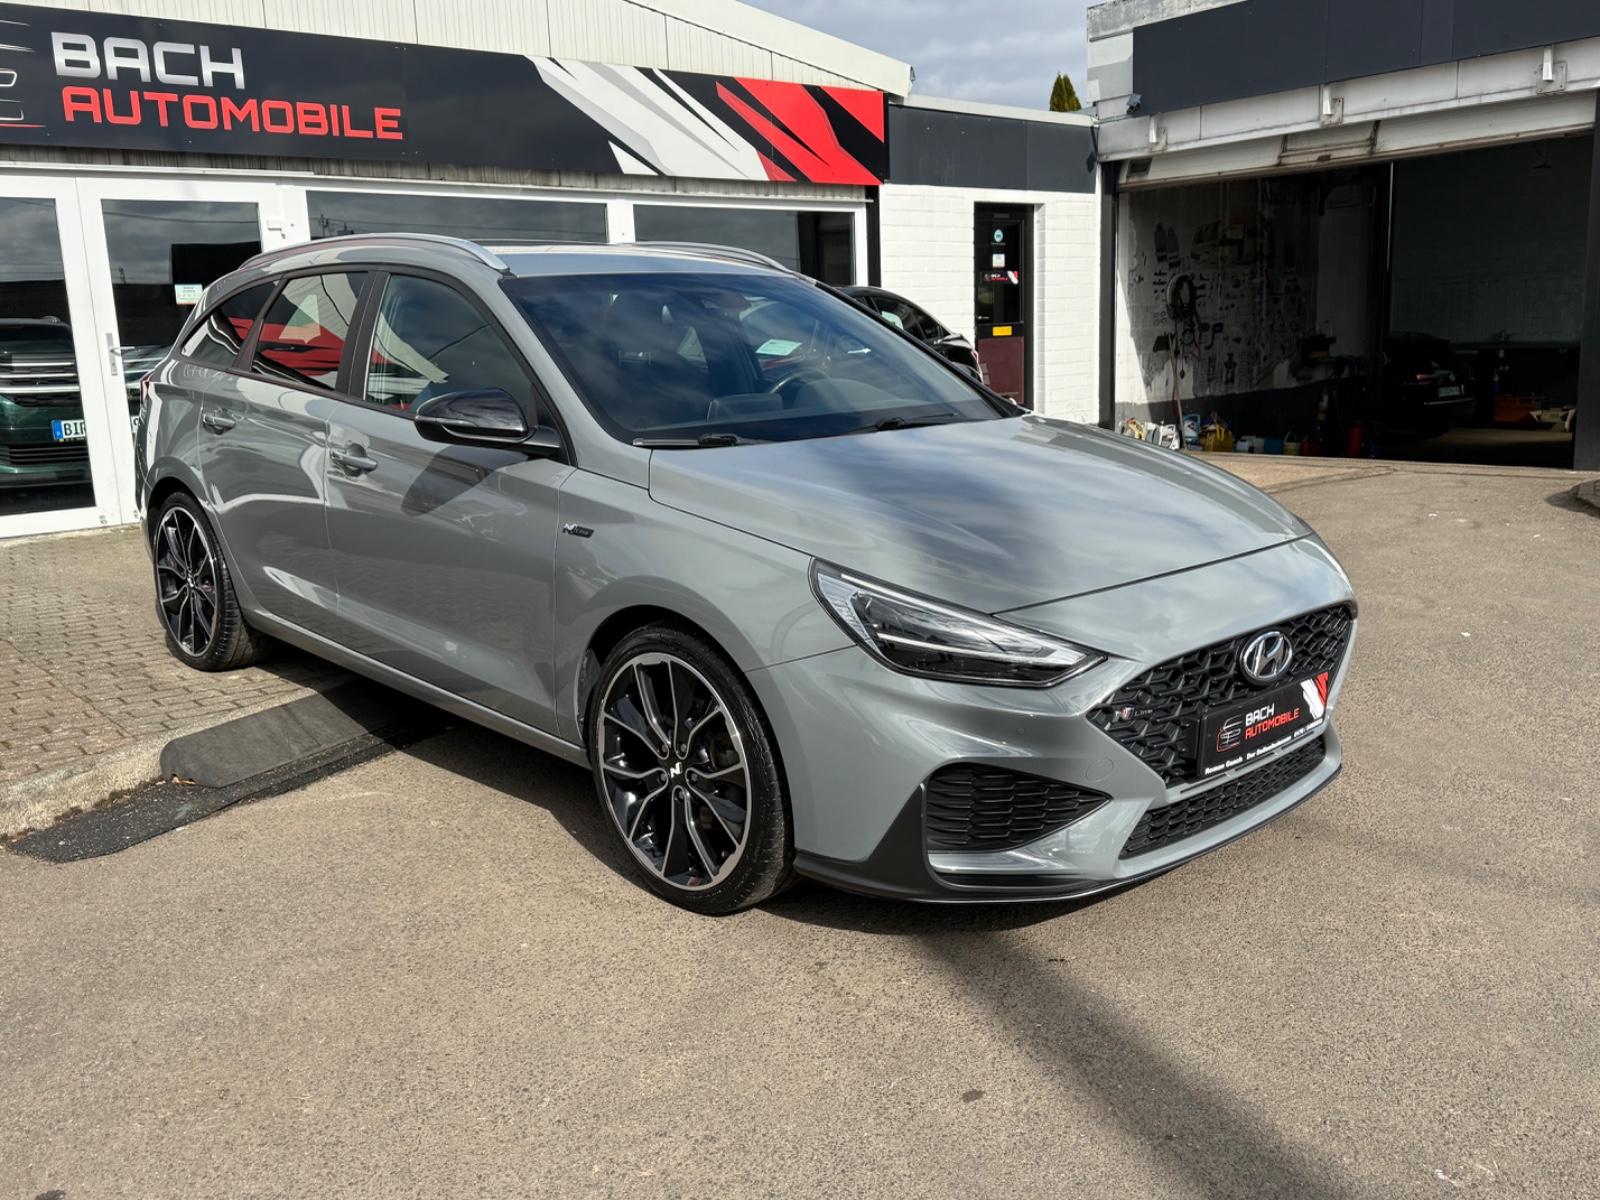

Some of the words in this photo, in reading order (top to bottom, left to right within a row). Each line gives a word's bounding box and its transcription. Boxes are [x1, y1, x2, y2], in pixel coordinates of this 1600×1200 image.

[51, 31, 245, 90] BACH
[62, 85, 403, 140] AUTOMOBILE
[1245, 703, 1275, 727] BACH
[1245, 707, 1300, 740] AUTOMOBILE
